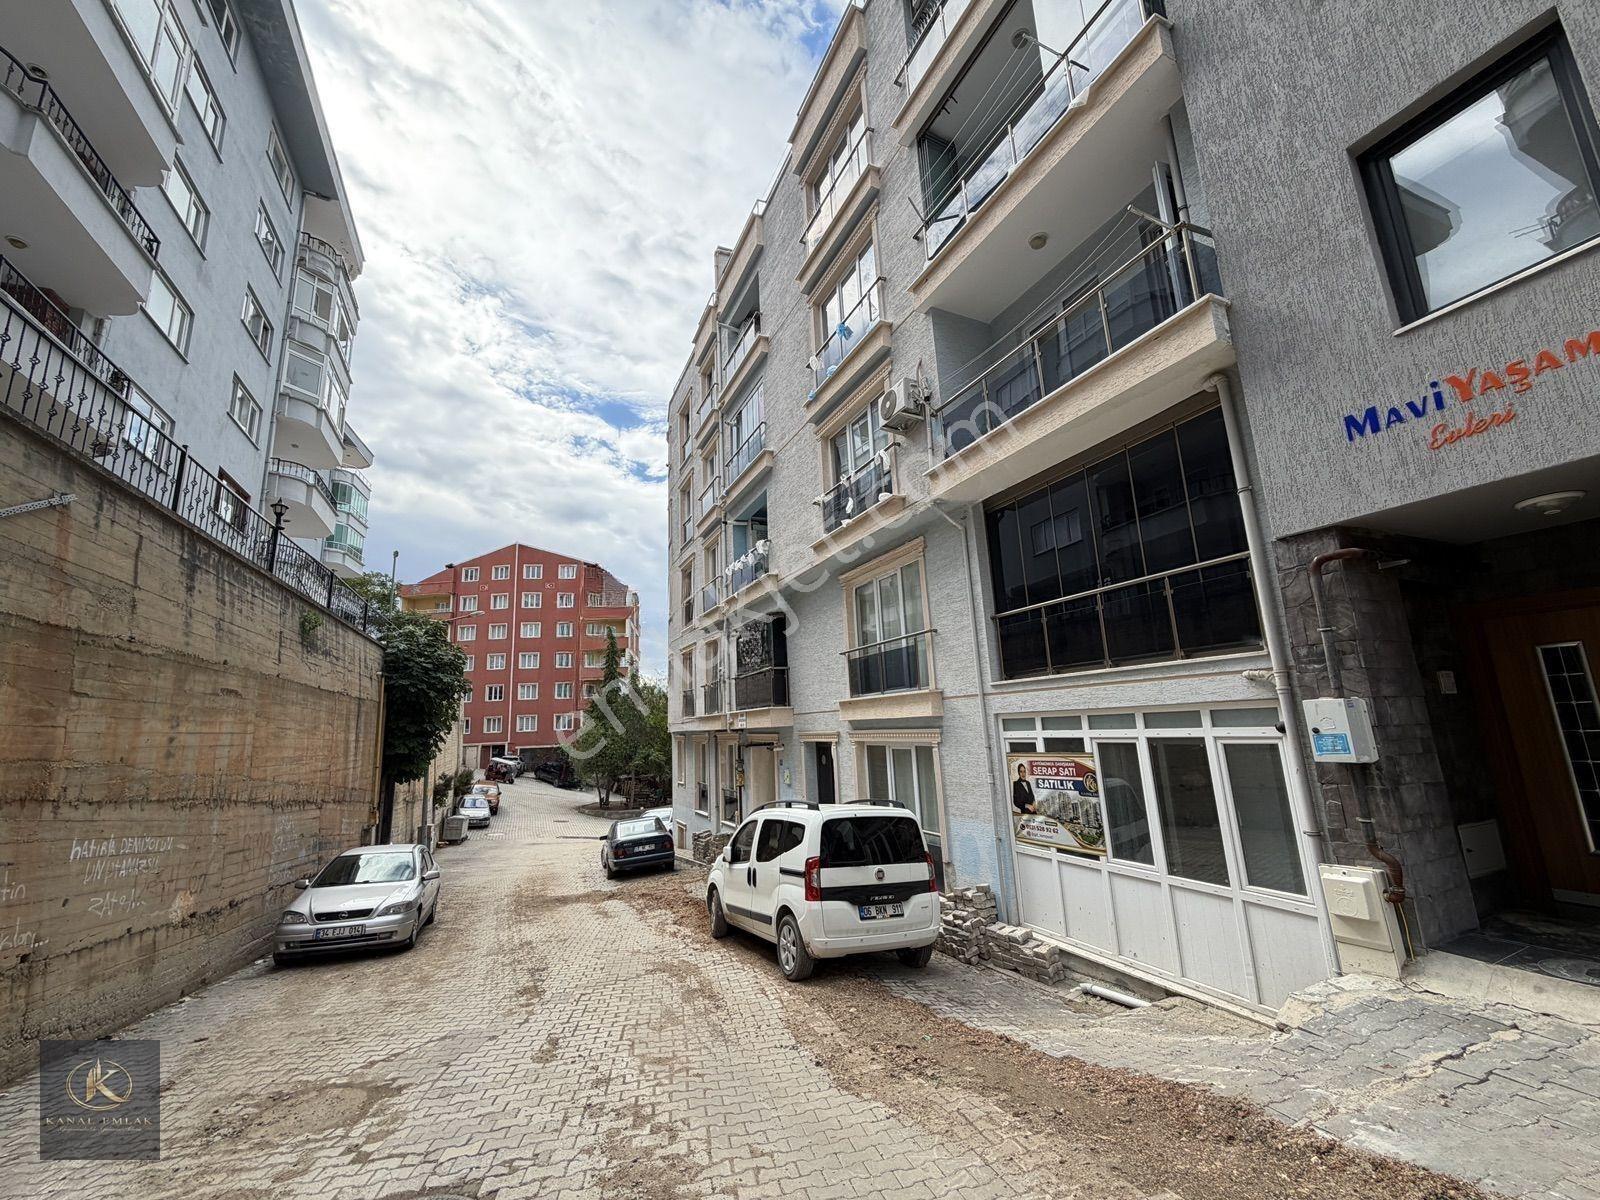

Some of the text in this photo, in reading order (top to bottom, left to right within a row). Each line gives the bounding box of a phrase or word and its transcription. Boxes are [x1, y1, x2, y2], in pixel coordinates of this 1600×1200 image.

[1429, 402, 1516, 450] Evleri
[1032, 766, 1076, 776] SERAP SATI
[1038, 779, 1074, 790] SATILIK
[863, 905, 872, 917] 06
[875, 904, 888, 915] BKN
[320, 929, 329, 938] 34
